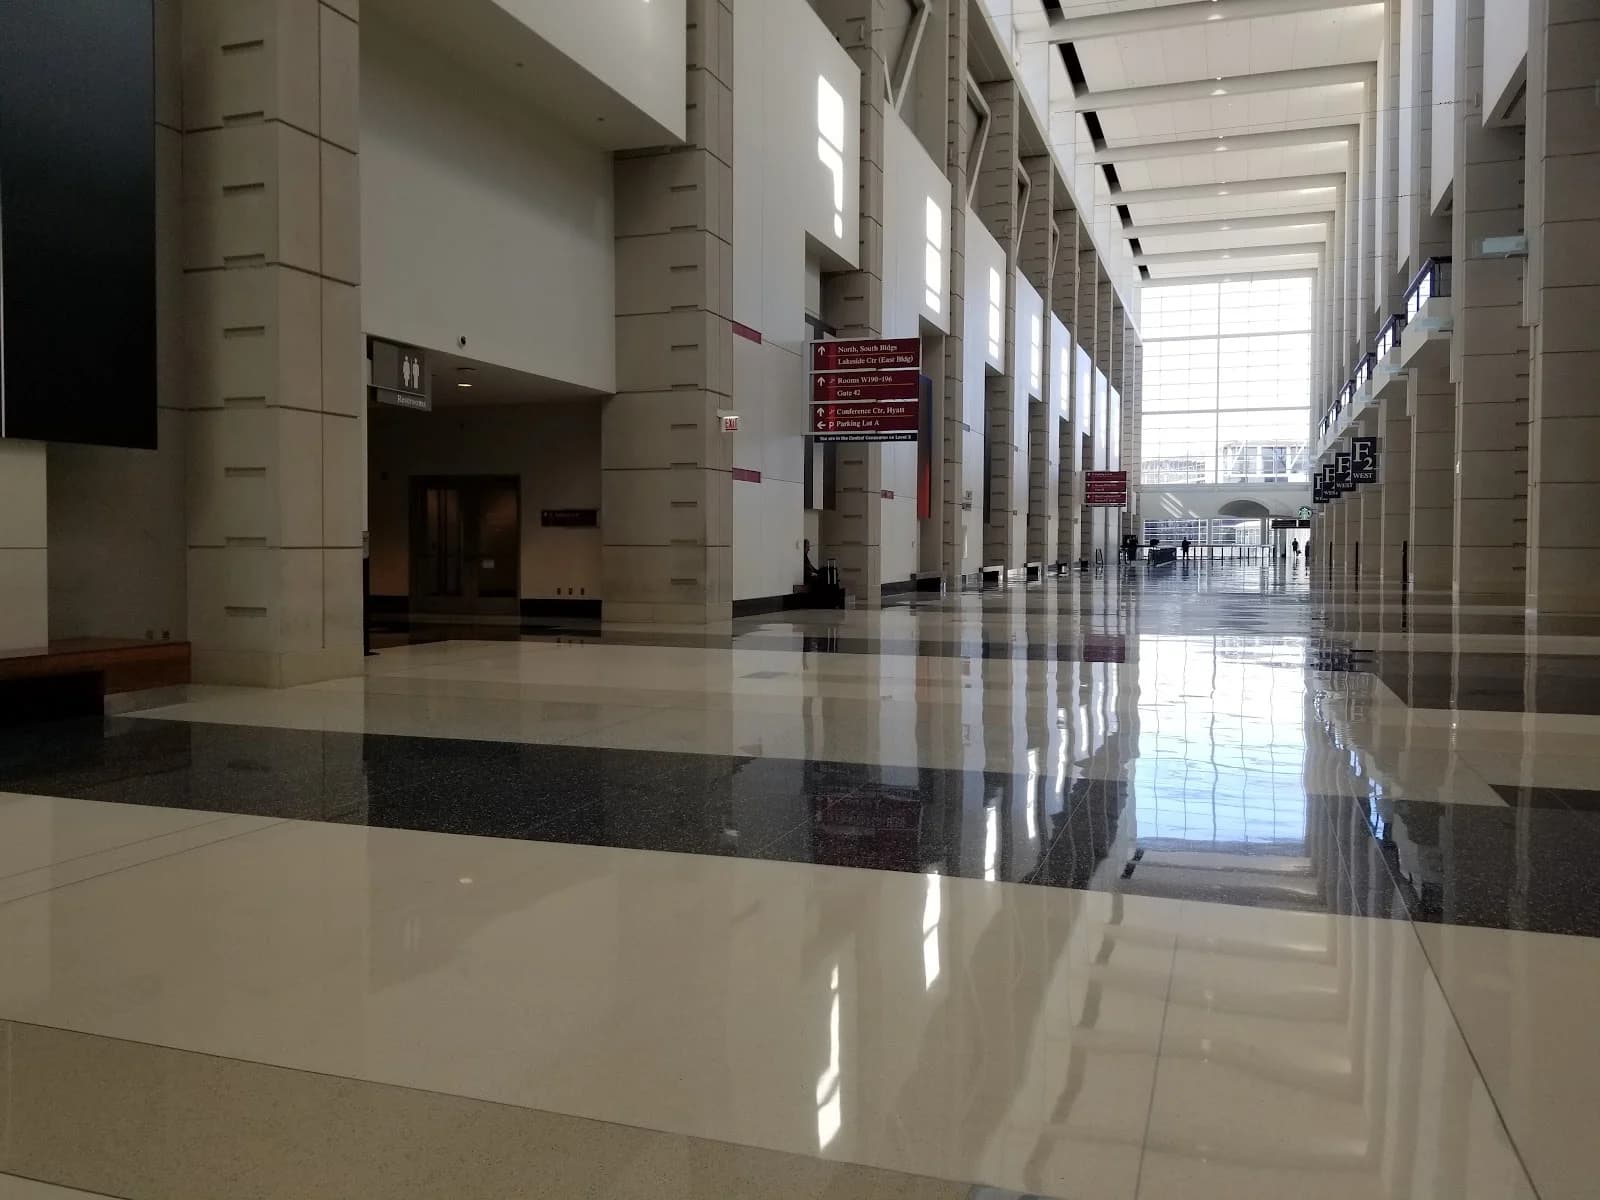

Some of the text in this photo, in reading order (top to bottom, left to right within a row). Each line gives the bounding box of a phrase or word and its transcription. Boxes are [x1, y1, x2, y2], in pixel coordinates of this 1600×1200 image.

[838, 343, 898, 353] North, South Bldgs
[838, 354, 914, 365] Lakeside Ctr (East Bldg)
[837, 389, 852, 397] Gate
[836, 407, 871, 415] Conference
[886, 406, 905, 415] Hyatt
[725, 417, 737, 429] EXIT
[836, 420, 861, 429] Parking
[862, 419, 873, 427] Lot
